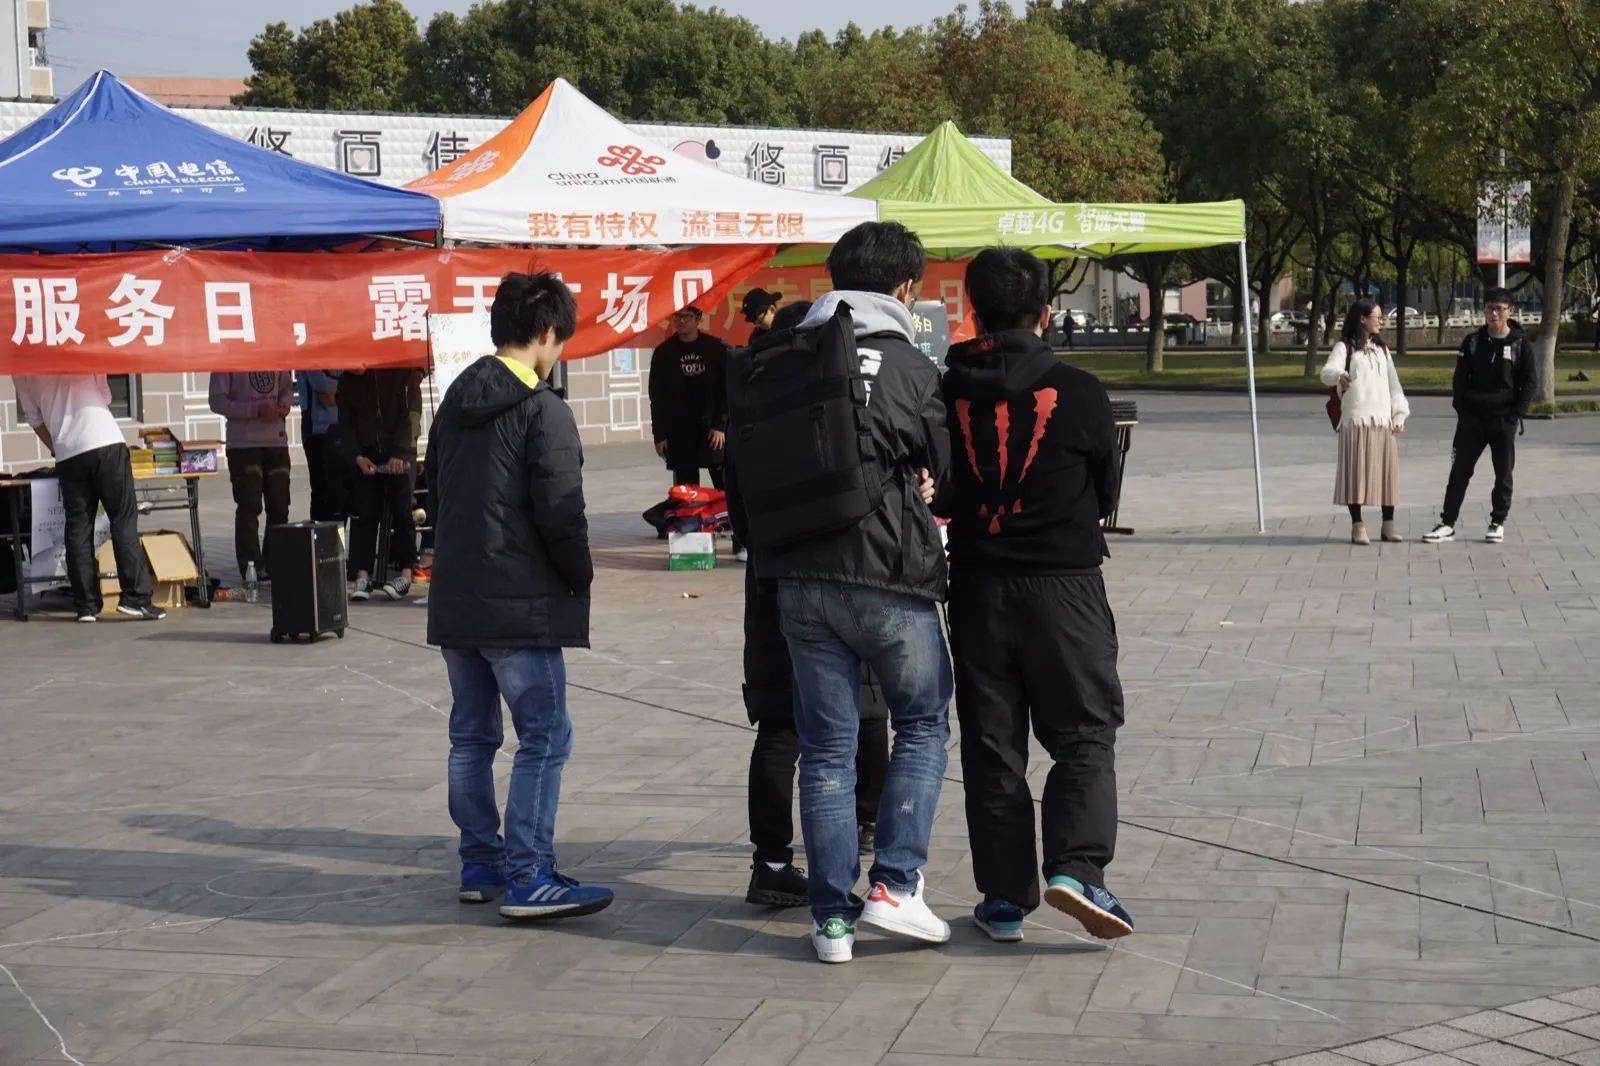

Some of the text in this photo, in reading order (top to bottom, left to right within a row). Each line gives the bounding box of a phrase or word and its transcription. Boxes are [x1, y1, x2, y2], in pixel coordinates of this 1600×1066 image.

[115, 159, 234, 182] 中国电信
[123, 176, 241, 186] CHINA TELECOM
[528, 211, 807, 239] 我有特权 流量无限
[996, 210, 1066, 235] 卓越4G
